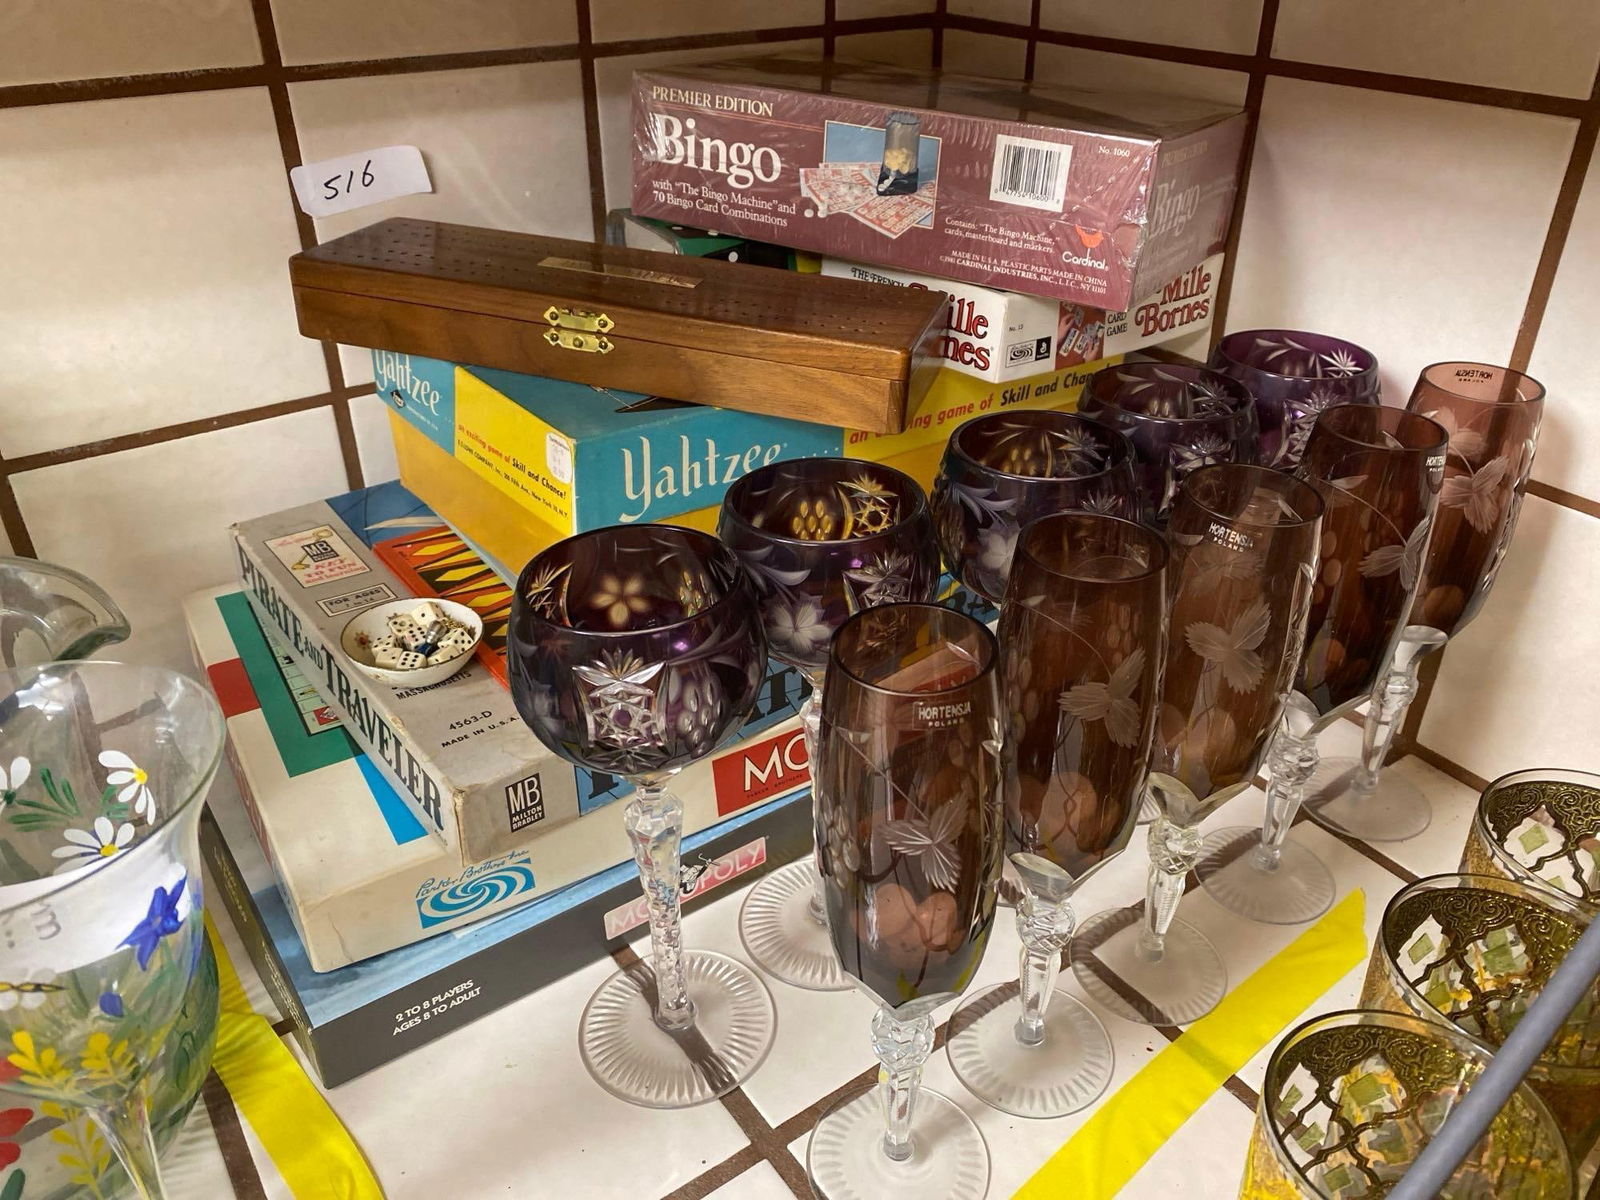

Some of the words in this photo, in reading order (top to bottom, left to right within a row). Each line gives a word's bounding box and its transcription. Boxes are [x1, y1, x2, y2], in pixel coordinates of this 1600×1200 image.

[652, 85, 712, 108] PREMIER
[714, 96, 774, 118] EDITION
[651, 112, 782, 189] Bingo
[1098, 145, 1111, 154] No.
[1112, 146, 1131, 158] 1060
[323, 159, 376, 201] 516
[652, 179, 673, 192] with
[701, 183, 729, 203] Bingo
[777, 199, 796, 215] and
[652, 191, 666, 204] 70
[667, 194, 695, 210] Bingo
[696, 198, 719, 214] Card
[720, 204, 788, 228] Combinations
[944, 227, 965, 239] cards,
[965, 231, 1008, 246] masterboard
[1008, 238, 1023, 248] and
[1024, 241, 1054, 254] markers.
[945, 217, 978, 230] Contains:
[999, 226, 1021, 239] Bingo
[851, 267, 870, 282] THE
[951, 250, 972, 260] MADE
[972, 253, 981, 262] IN
[1000, 258, 1030, 271] PLASTIC
[1030, 264, 1052, 276] PARTS
[1052, 268, 1074, 280] MADE
[1074, 273, 1084, 282] IN
[1084, 275, 1108, 287] CHINA
[956, 257, 993, 272] CARDINAL
[993, 264, 1040, 281] INDUSTRIES,
[1080, 282, 1092, 292] NY
[1062, 248, 1107, 270] Cardinal
[1158, 264, 1212, 306] Mille
[947, 294, 989, 339] ille
[1106, 322, 1128, 336] GAME
[1107, 312, 1127, 324] CARD
[1134, 298, 1210, 337] Bornes
[937, 401, 975, 425] game
[979, 392, 994, 411] of
[1000, 383, 1031, 407] Skill
[1034, 376, 1059, 397] and
[848, 430, 868, 445] an
[512, 457, 526, 473] Skill
[527, 470, 540, 482] and
[541, 476, 567, 500] Chance!
[303, 540, 332, 557] MB
[1213, 536, 1245, 553] POLAND
[234, 534, 305, 658] PIRATE
[328, 596, 350, 606] FOR
[354, 588, 382, 600] AGES
[304, 636, 324, 671] AND
[320, 642, 445, 832] TRAVELER
[448, 709, 493, 731] 4563-D
[441, 732, 470, 749] MADE
[472, 727, 485, 737] IN
[508, 774, 541, 814] MB
[511, 804, 543, 823] MILTON
[511, 811, 544, 831] BRADLEY
[392, 1015, 422, 1036] AGES
[423, 1010, 431, 1021] 8
[431, 1003, 448, 1017] TO
[449, 986, 482, 1008] ADULT
[395, 1012, 404, 1023] 2
[404, 1004, 421, 1018] TO
[422, 1000, 430, 1011] 8
[431, 978, 475, 1006] PLAYERS
